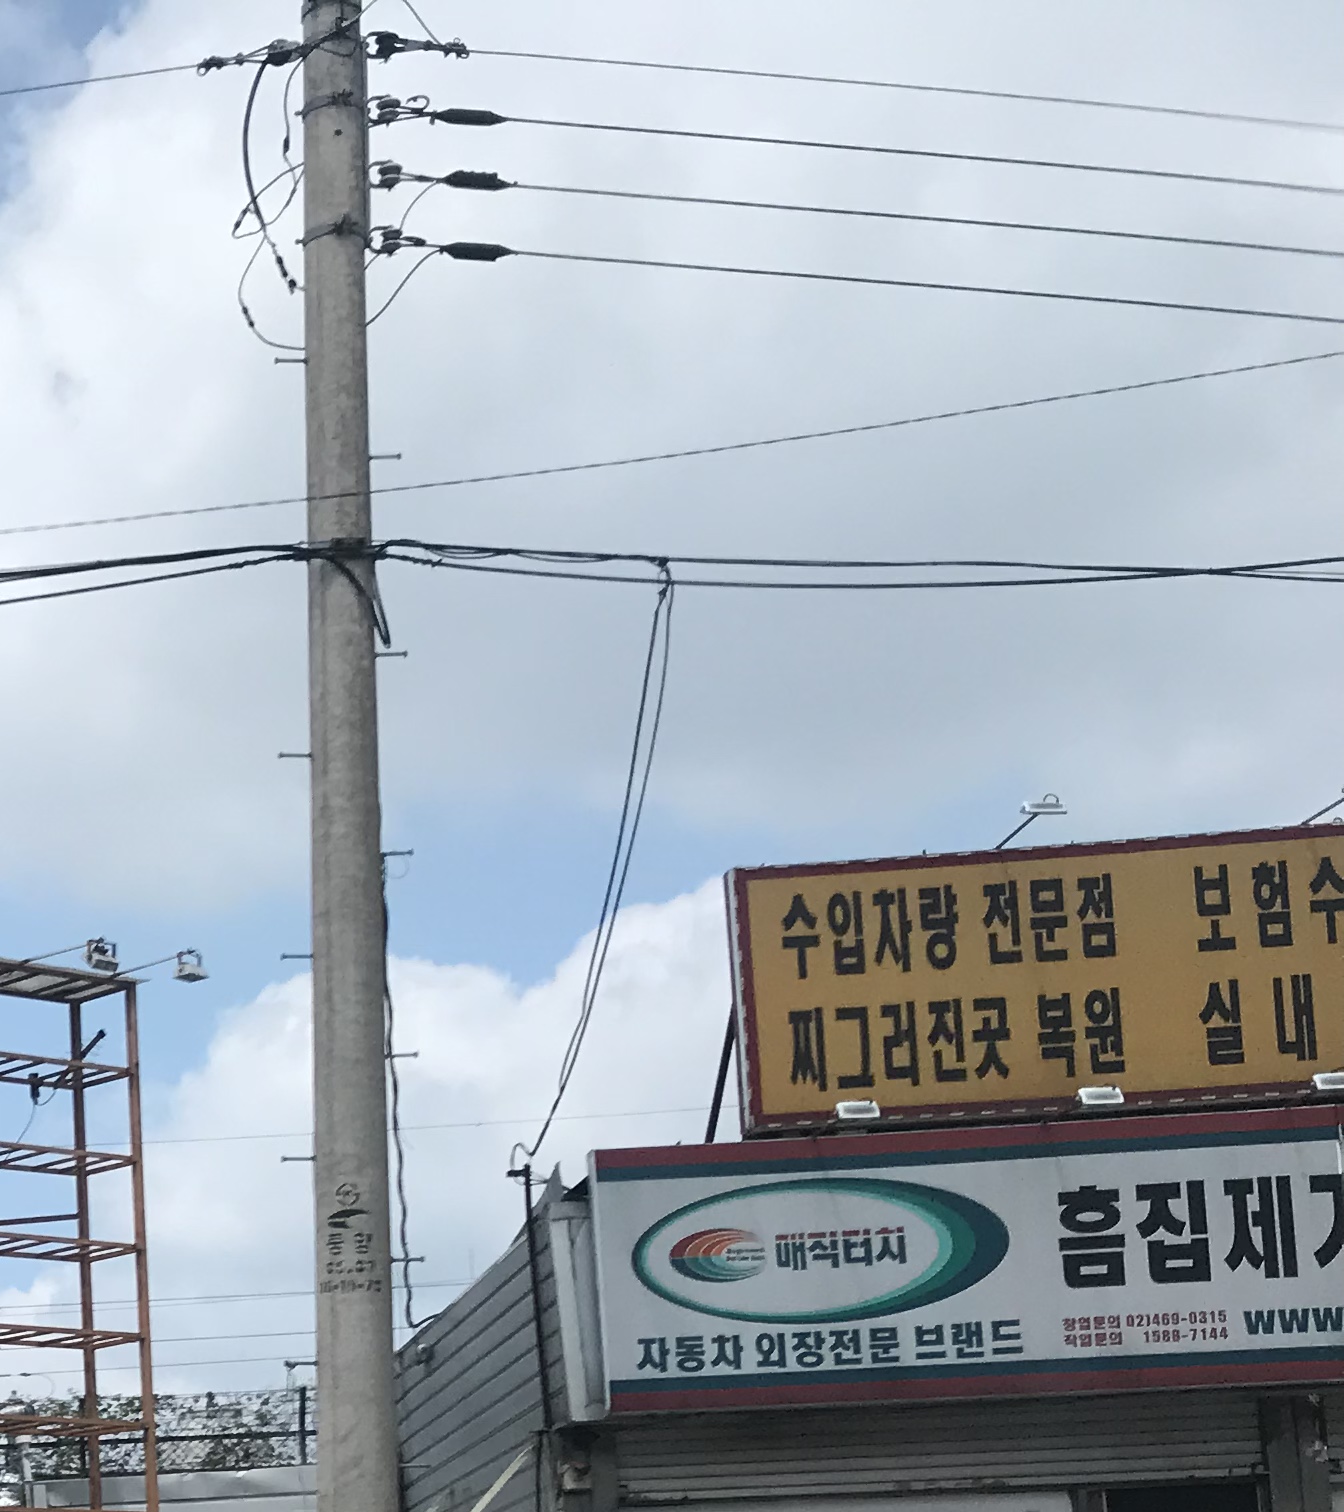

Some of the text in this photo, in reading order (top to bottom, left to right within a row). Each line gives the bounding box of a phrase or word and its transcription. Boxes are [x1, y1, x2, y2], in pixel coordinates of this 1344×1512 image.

[781, 884, 960, 980] 수입차량
[982, 873, 1117, 966] 전문점
[1036, 987, 1125, 1077] 복원
[775, 1226, 908, 1271] 매직터치
[635, 1318, 1025, 1374] 자동차 외장전문 브랜드
[1143, 1327, 1229, 1344] 1588-7144
